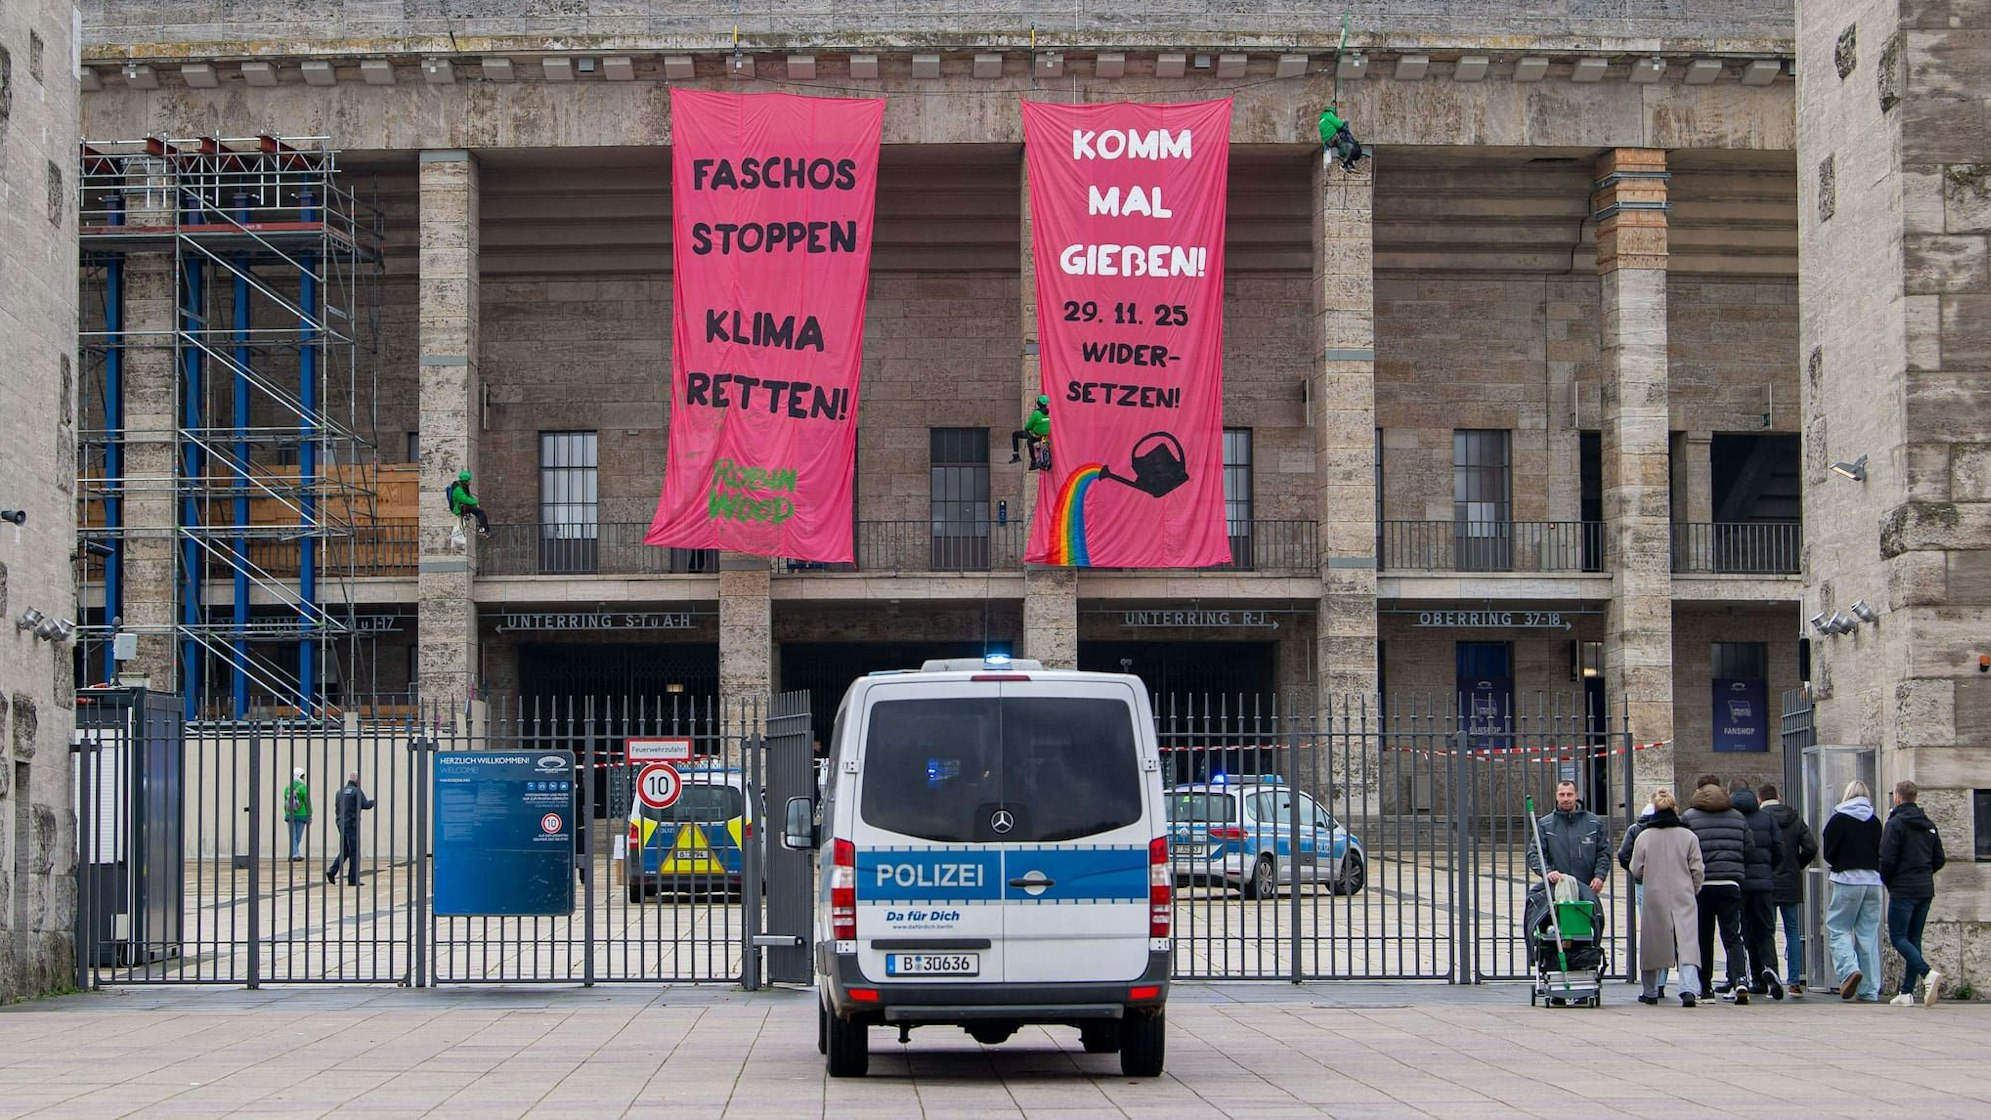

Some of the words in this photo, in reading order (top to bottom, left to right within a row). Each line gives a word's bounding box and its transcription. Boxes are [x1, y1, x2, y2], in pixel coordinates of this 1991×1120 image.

[1072, 128, 1192, 161] KOMM
[693, 156, 856, 191] FASCHOS
[1088, 185, 1172, 218] MAL
[692, 221, 857, 255] STOPPEN
[1064, 301, 1103, 323] 29.
[1114, 302, 1143, 325] 11.
[1154, 304, 1188, 326] 25
[706, 309, 825, 352] KLIMA
[1082, 342, 1181, 367] WIDER-
[687, 373, 848, 421] RETTEN!
[1066, 381, 1181, 408] SETZEN!
[709, 489, 795, 524] WOOD
[507, 615, 612, 628] UNTERRING
[1125, 612, 1230, 625] UNTERRING
[1419, 612, 1512, 626] OBERRING
[1524, 612, 1561, 626] 37-18
[1723, 727, 1755, 735] FANSHOP
[440, 757, 476, 765] HERZLICH
[477, 757, 530, 765] WILLKOMMEN!
[649, 776, 669, 795] 10
[546, 818, 557, 828] 10
[877, 864, 984, 887] POLIZEI
[886, 911, 904, 921] Da
[907, 910, 928, 921] für
[930, 910, 961, 921] Dich
[923, 957, 970, 971] 30636
